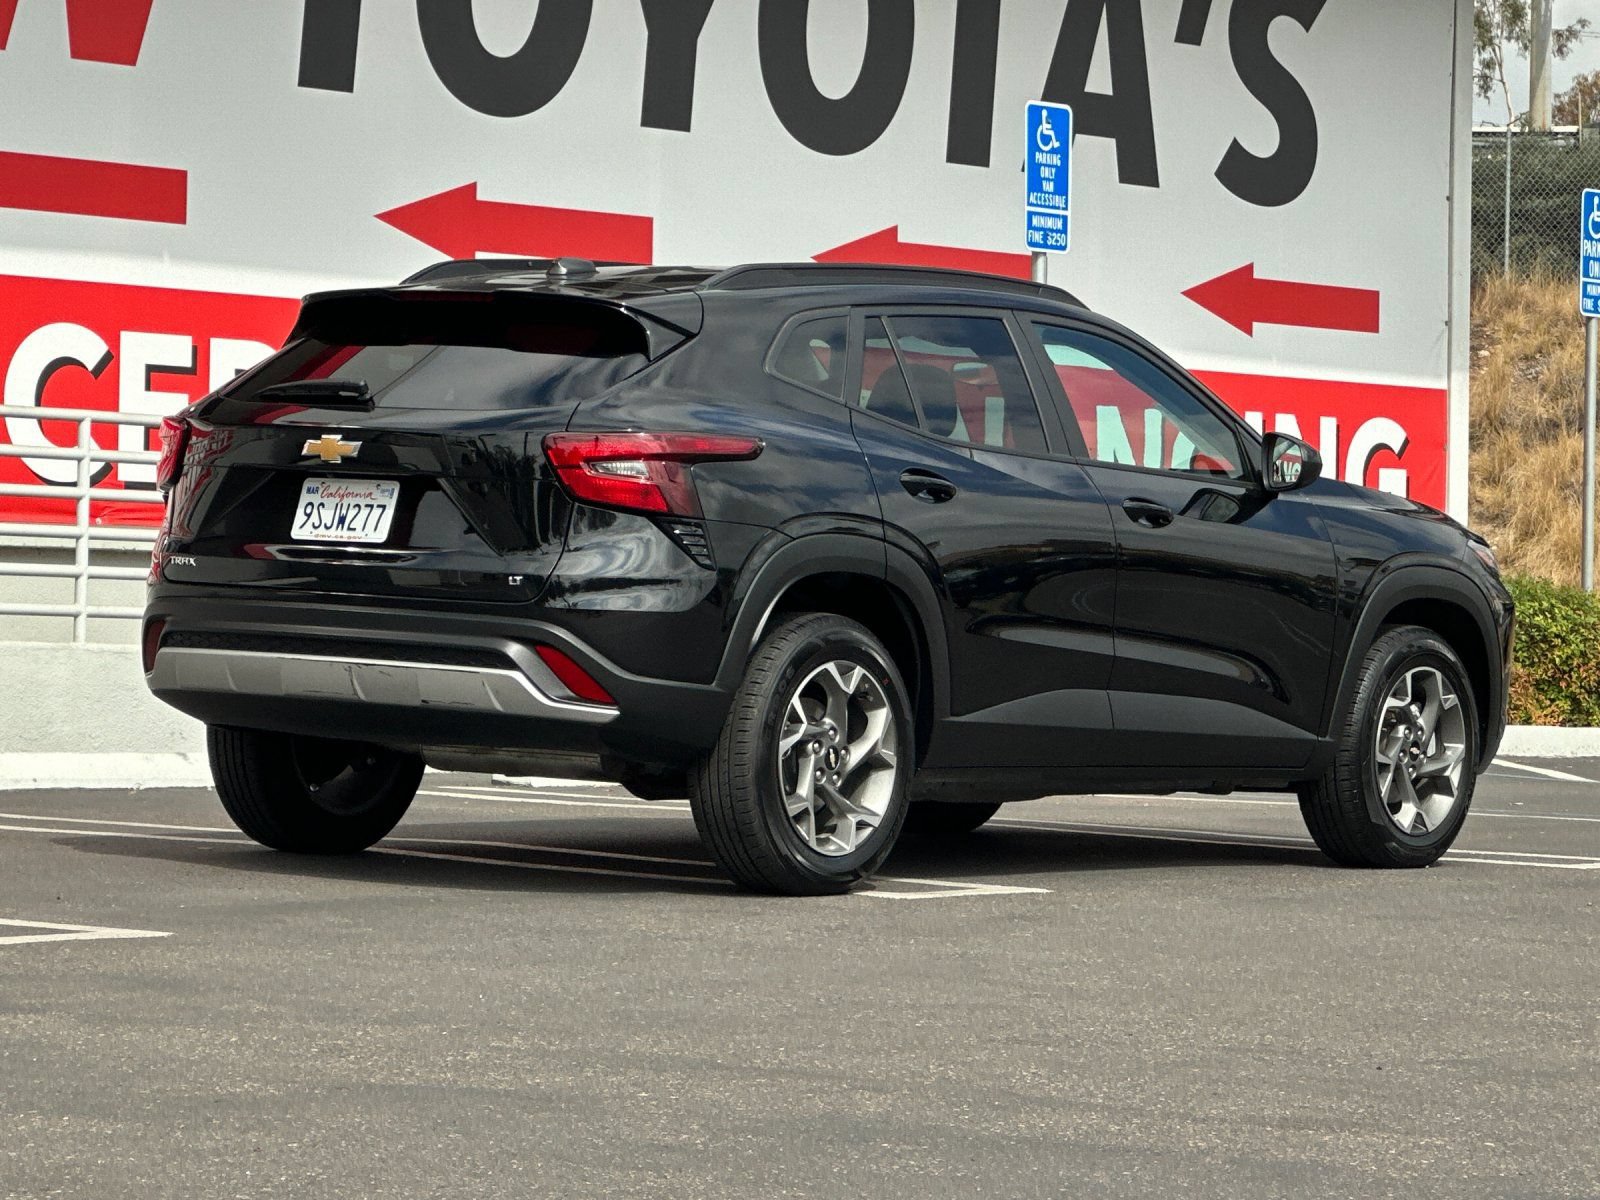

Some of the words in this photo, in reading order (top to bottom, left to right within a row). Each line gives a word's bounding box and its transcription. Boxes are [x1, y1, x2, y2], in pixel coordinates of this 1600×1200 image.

[1036, 152, 1062, 167] PARKING
[1040, 166, 1056, 179] ONLY
[1042, 180, 1054, 193] VAN
[1029, 193, 1066, 207] ACCESSIBLE
[1032, 215, 1063, 230] MINIMUM
[1028, 230, 1044, 244] FINE
[305, 486, 320, 495] MAR
[320, 484, 378, 503] California
[299, 501, 387, 532] 9SJW277
[170, 556, 197, 567] TRAX
[508, 575, 523, 586] LT
